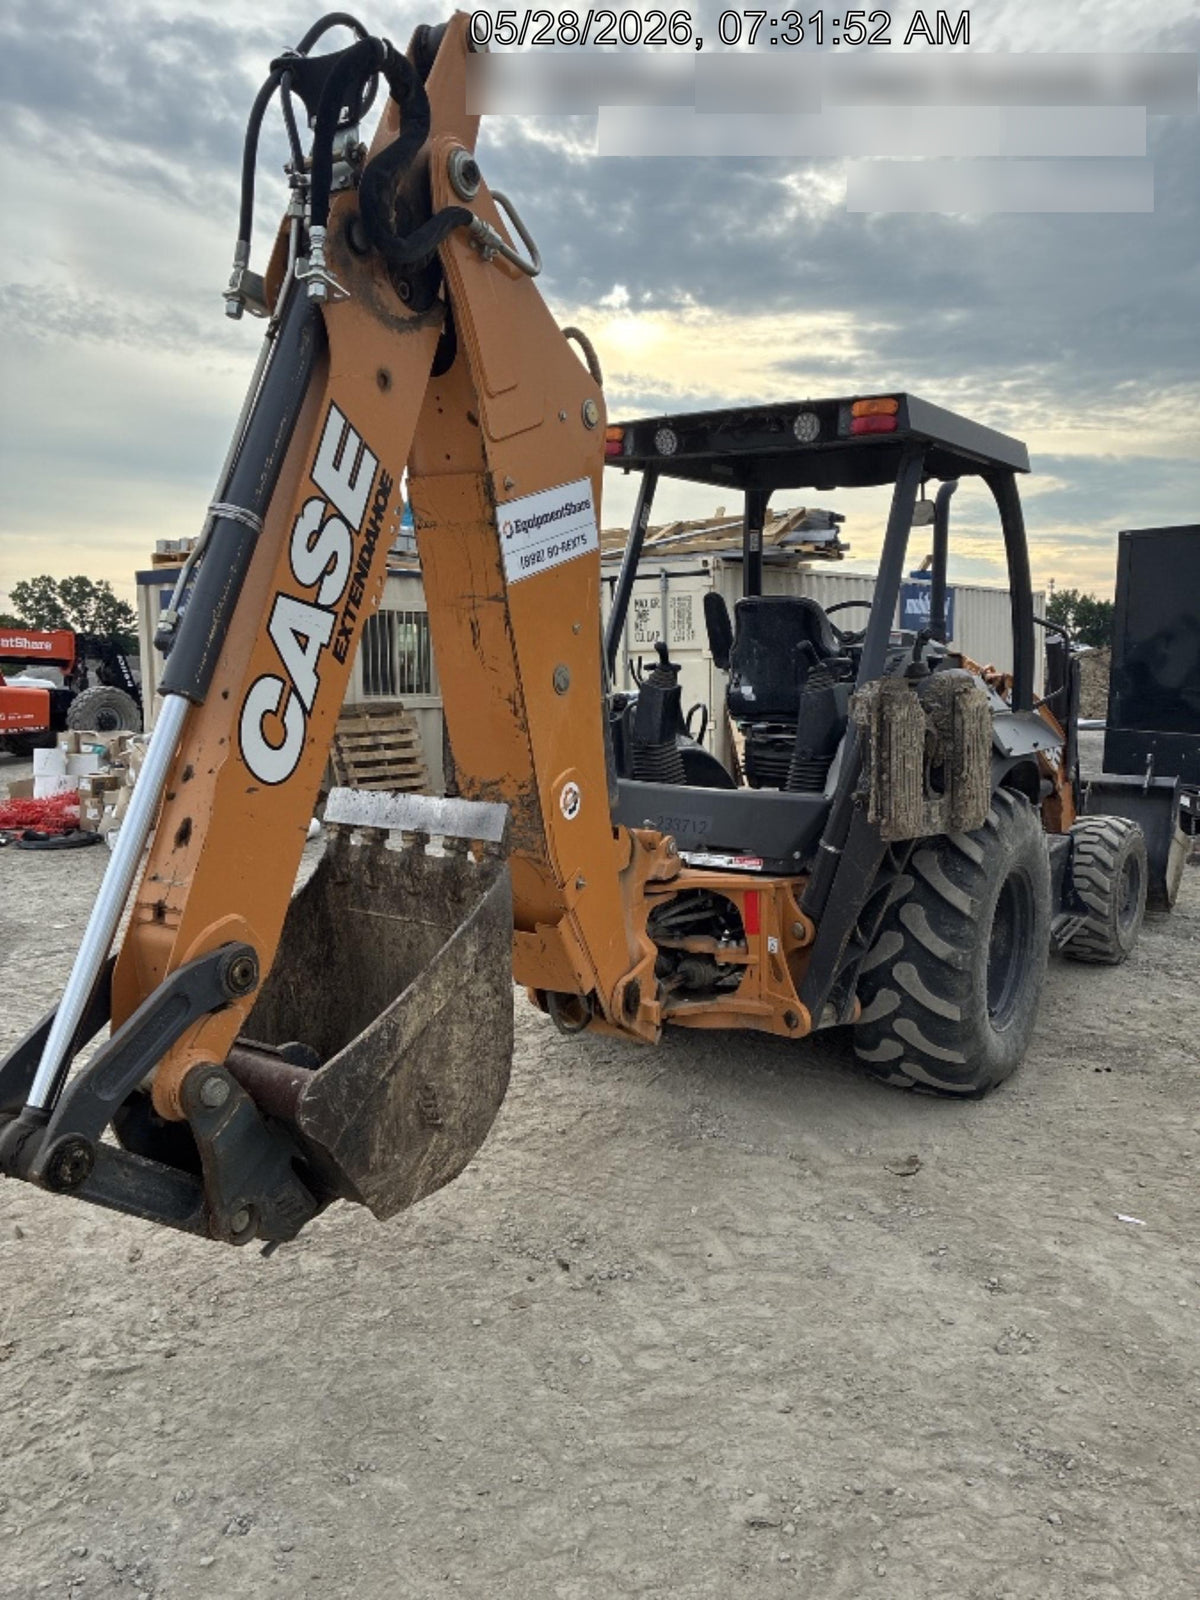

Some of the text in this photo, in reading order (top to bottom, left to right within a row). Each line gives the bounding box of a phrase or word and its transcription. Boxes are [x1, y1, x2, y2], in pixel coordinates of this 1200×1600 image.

[238, 399, 380, 786] CASE
[331, 469, 393, 665] EXTENDAHOE
[513, 499, 591, 535] EquipmentShare
